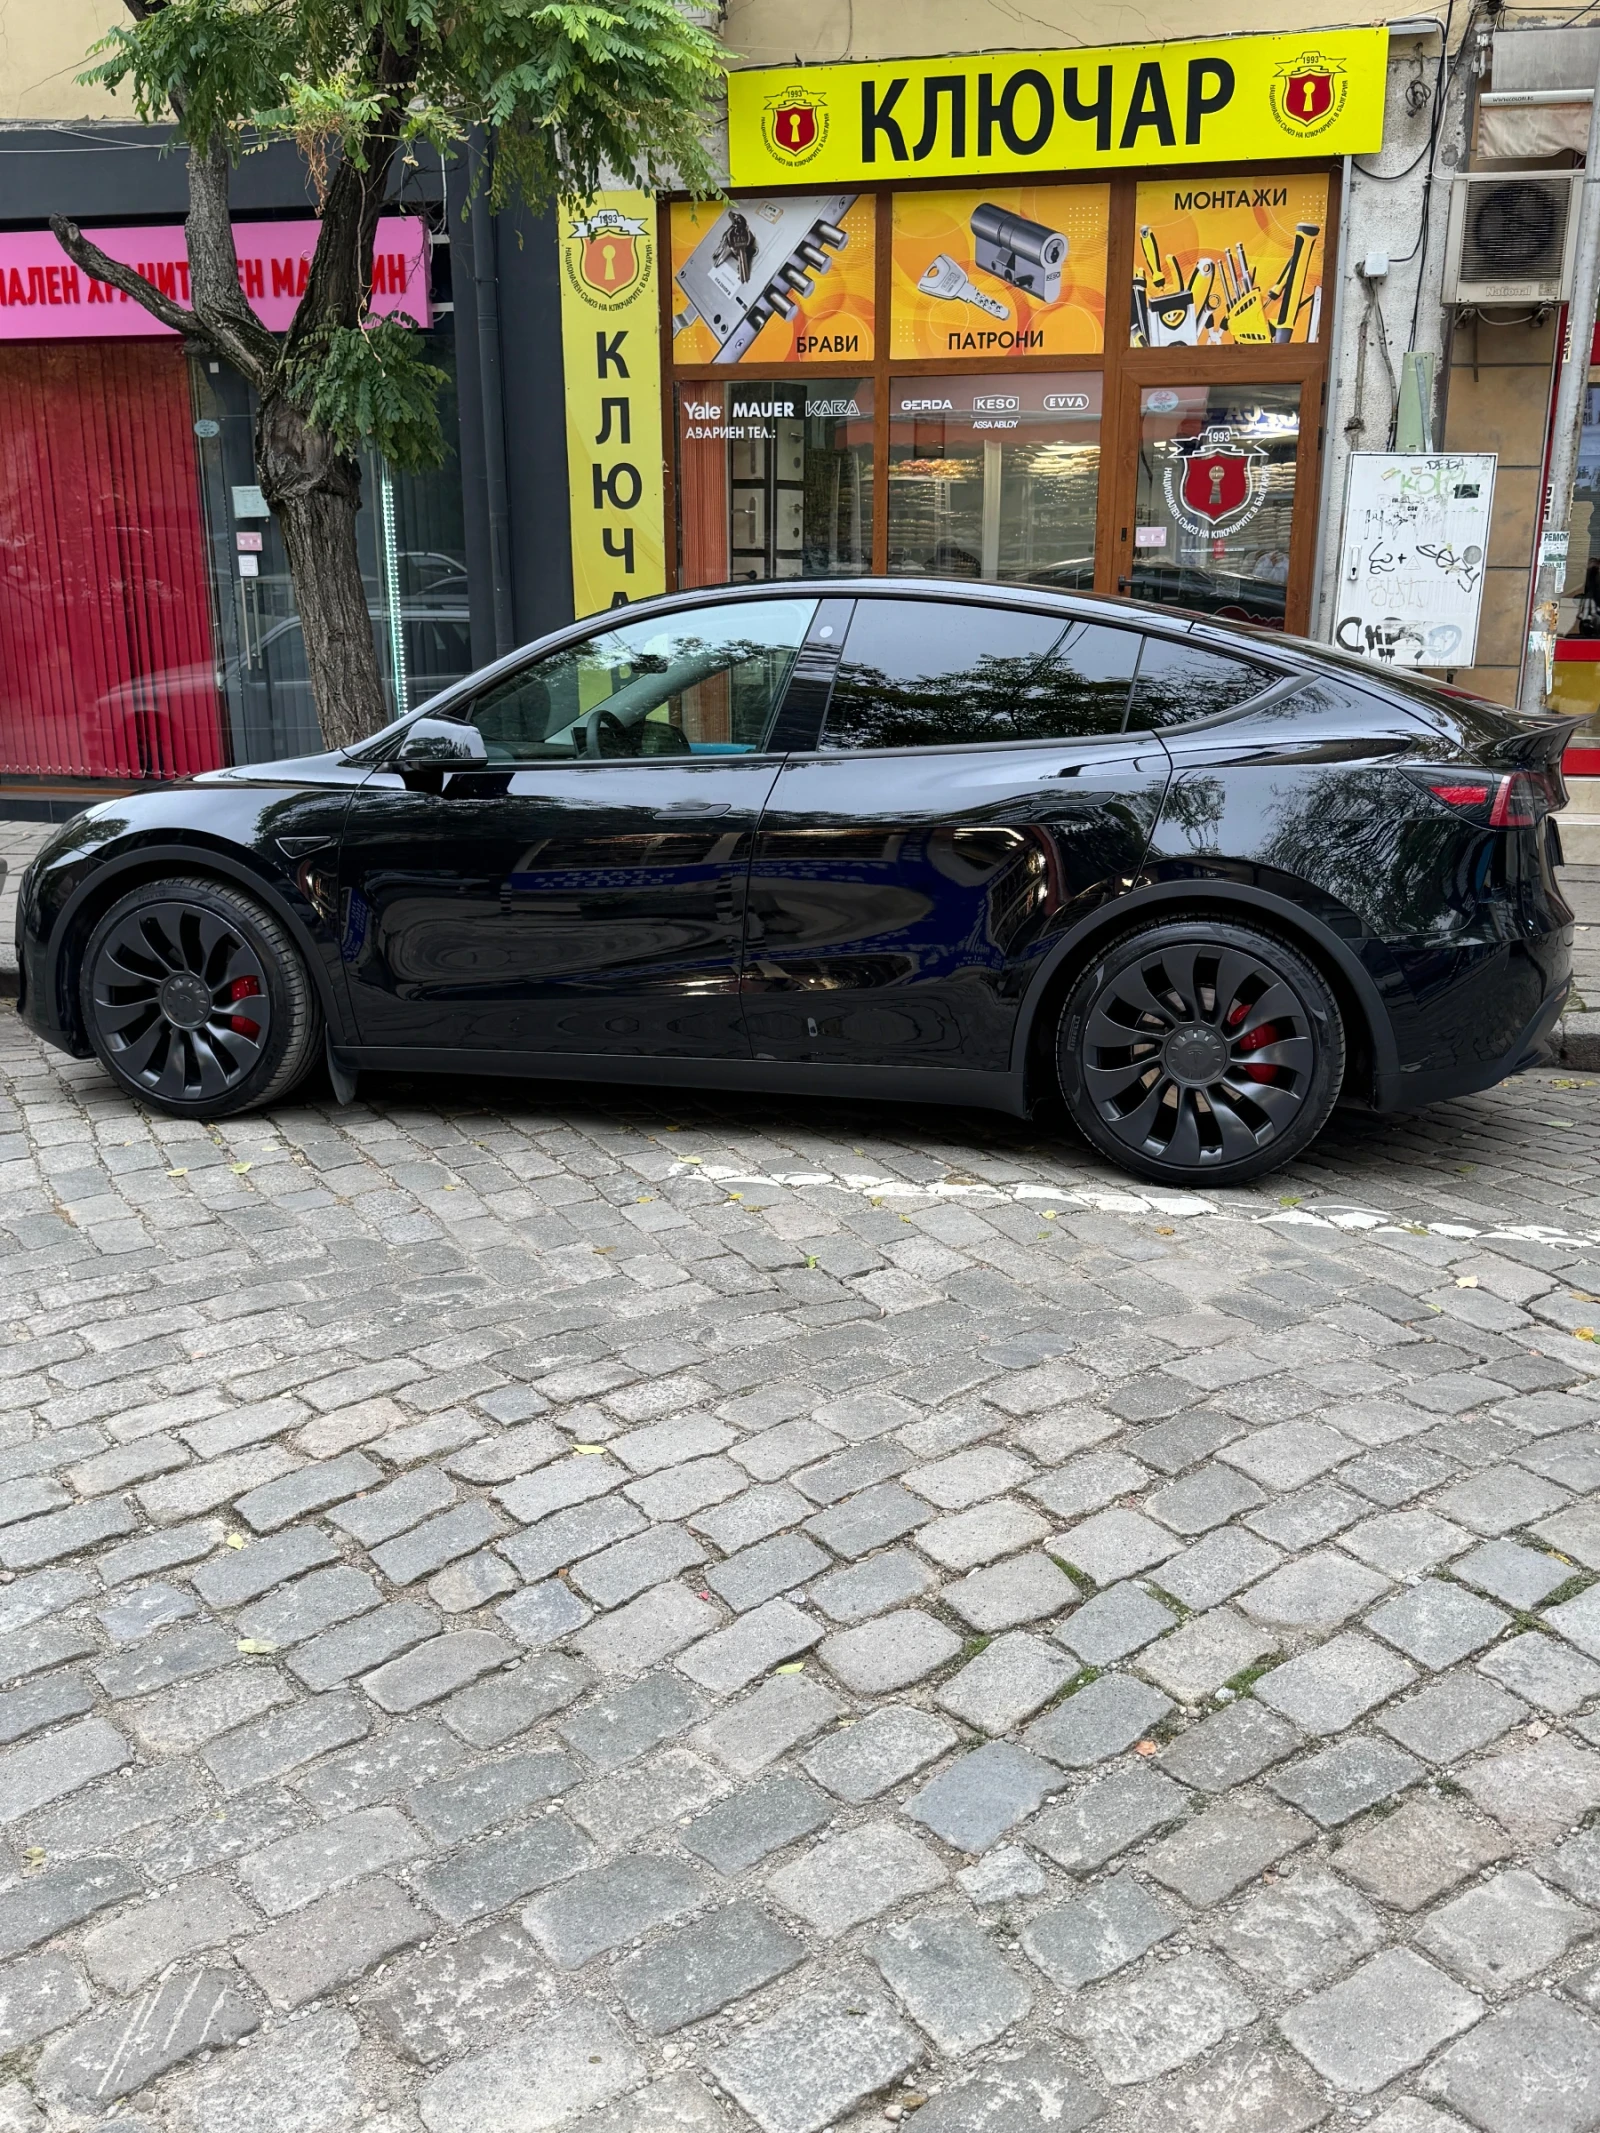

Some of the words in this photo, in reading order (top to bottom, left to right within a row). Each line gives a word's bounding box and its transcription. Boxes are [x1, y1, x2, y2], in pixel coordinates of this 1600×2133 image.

[1303, 56, 1319, 64] 1993
[787, 90, 803, 98] 1993
[861, 57, 1236, 164] КЛЮЧАР
[1269, 84, 1283, 124] НАЦИОНАЛЕН
[1280, 122, 1295, 136] СЪЮЗ
[1304, 116, 1337, 138] КЛЮЧАРИТЕ
[1336, 80, 1348, 112] БЪЛГАРИЯ
[786, 160, 794, 168] НА
[1174, 188, 1287, 210] МОНТАЖИ
[565, 247, 583, 294] НАЦИОНАЛЕН
[580, 292, 598, 308] СЪЮЗ
[598, 303, 608, 311] НА
[608, 286, 643, 312] КЛЮЧАРИТЕ
[642, 244, 652, 282] БЪЛГАРИЯ
[1486, 285, 1532, 297] National
[796, 335, 858, 354] БРАВИ
[948, 330, 1044, 350] ПАТРОНИ
[901, 400, 953, 411] GERDA
[976, 398, 1016, 410] KESO
[1049, 397, 1084, 407] EVVA
[684, 402, 721, 420] Yale
[732, 402, 795, 418] MAUER
[972, 420, 993, 429] ASSA
[993, 420, 1018, 429] ABLOY
[685, 427, 744, 439] АВАРИЕН
[748, 426, 776, 439] ТЕЛ.:
[1208, 432, 1230, 442] 1993
[1162, 467, 1182, 520] НАЦИОНАЛЕН
[1178, 517, 1199, 535] СЪЮЗ
[1198, 529, 1210, 538] НА
[1210, 511, 1254, 539] КЛЮЧАРИТЕ
